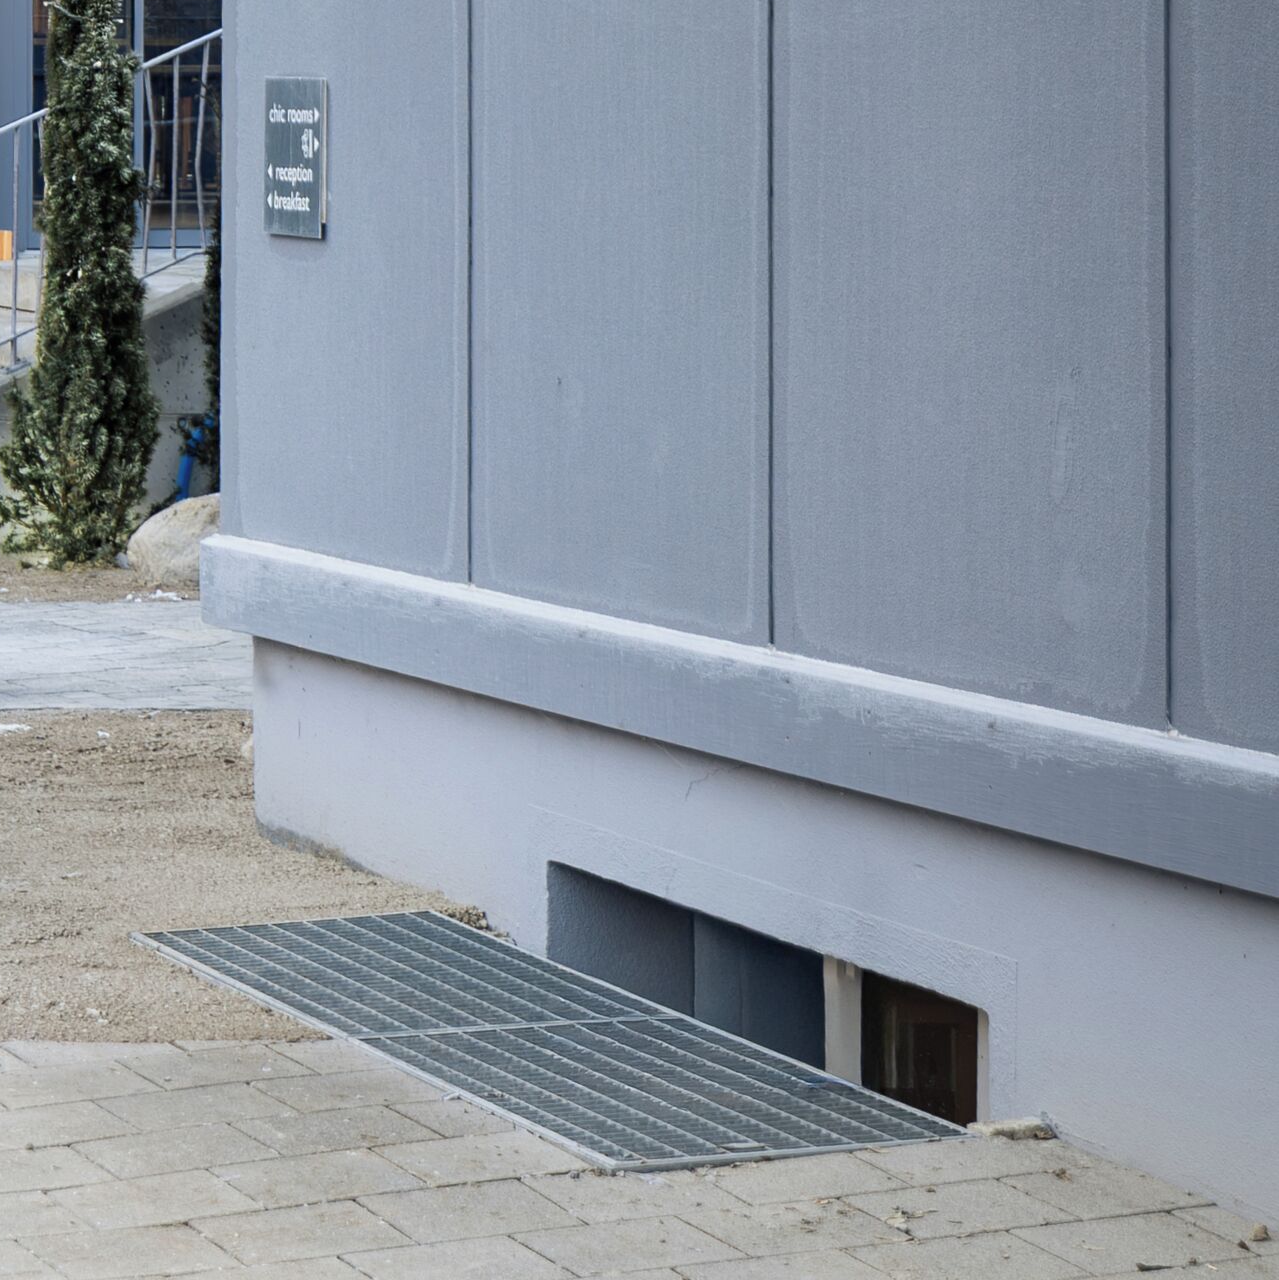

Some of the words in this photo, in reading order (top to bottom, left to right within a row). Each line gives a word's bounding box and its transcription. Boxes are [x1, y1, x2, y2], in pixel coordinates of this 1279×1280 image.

[269, 102, 286, 123] chic
[287, 108, 313, 124] rooms
[275, 163, 313, 187] reception
[273, 189, 310, 211] breakfast
